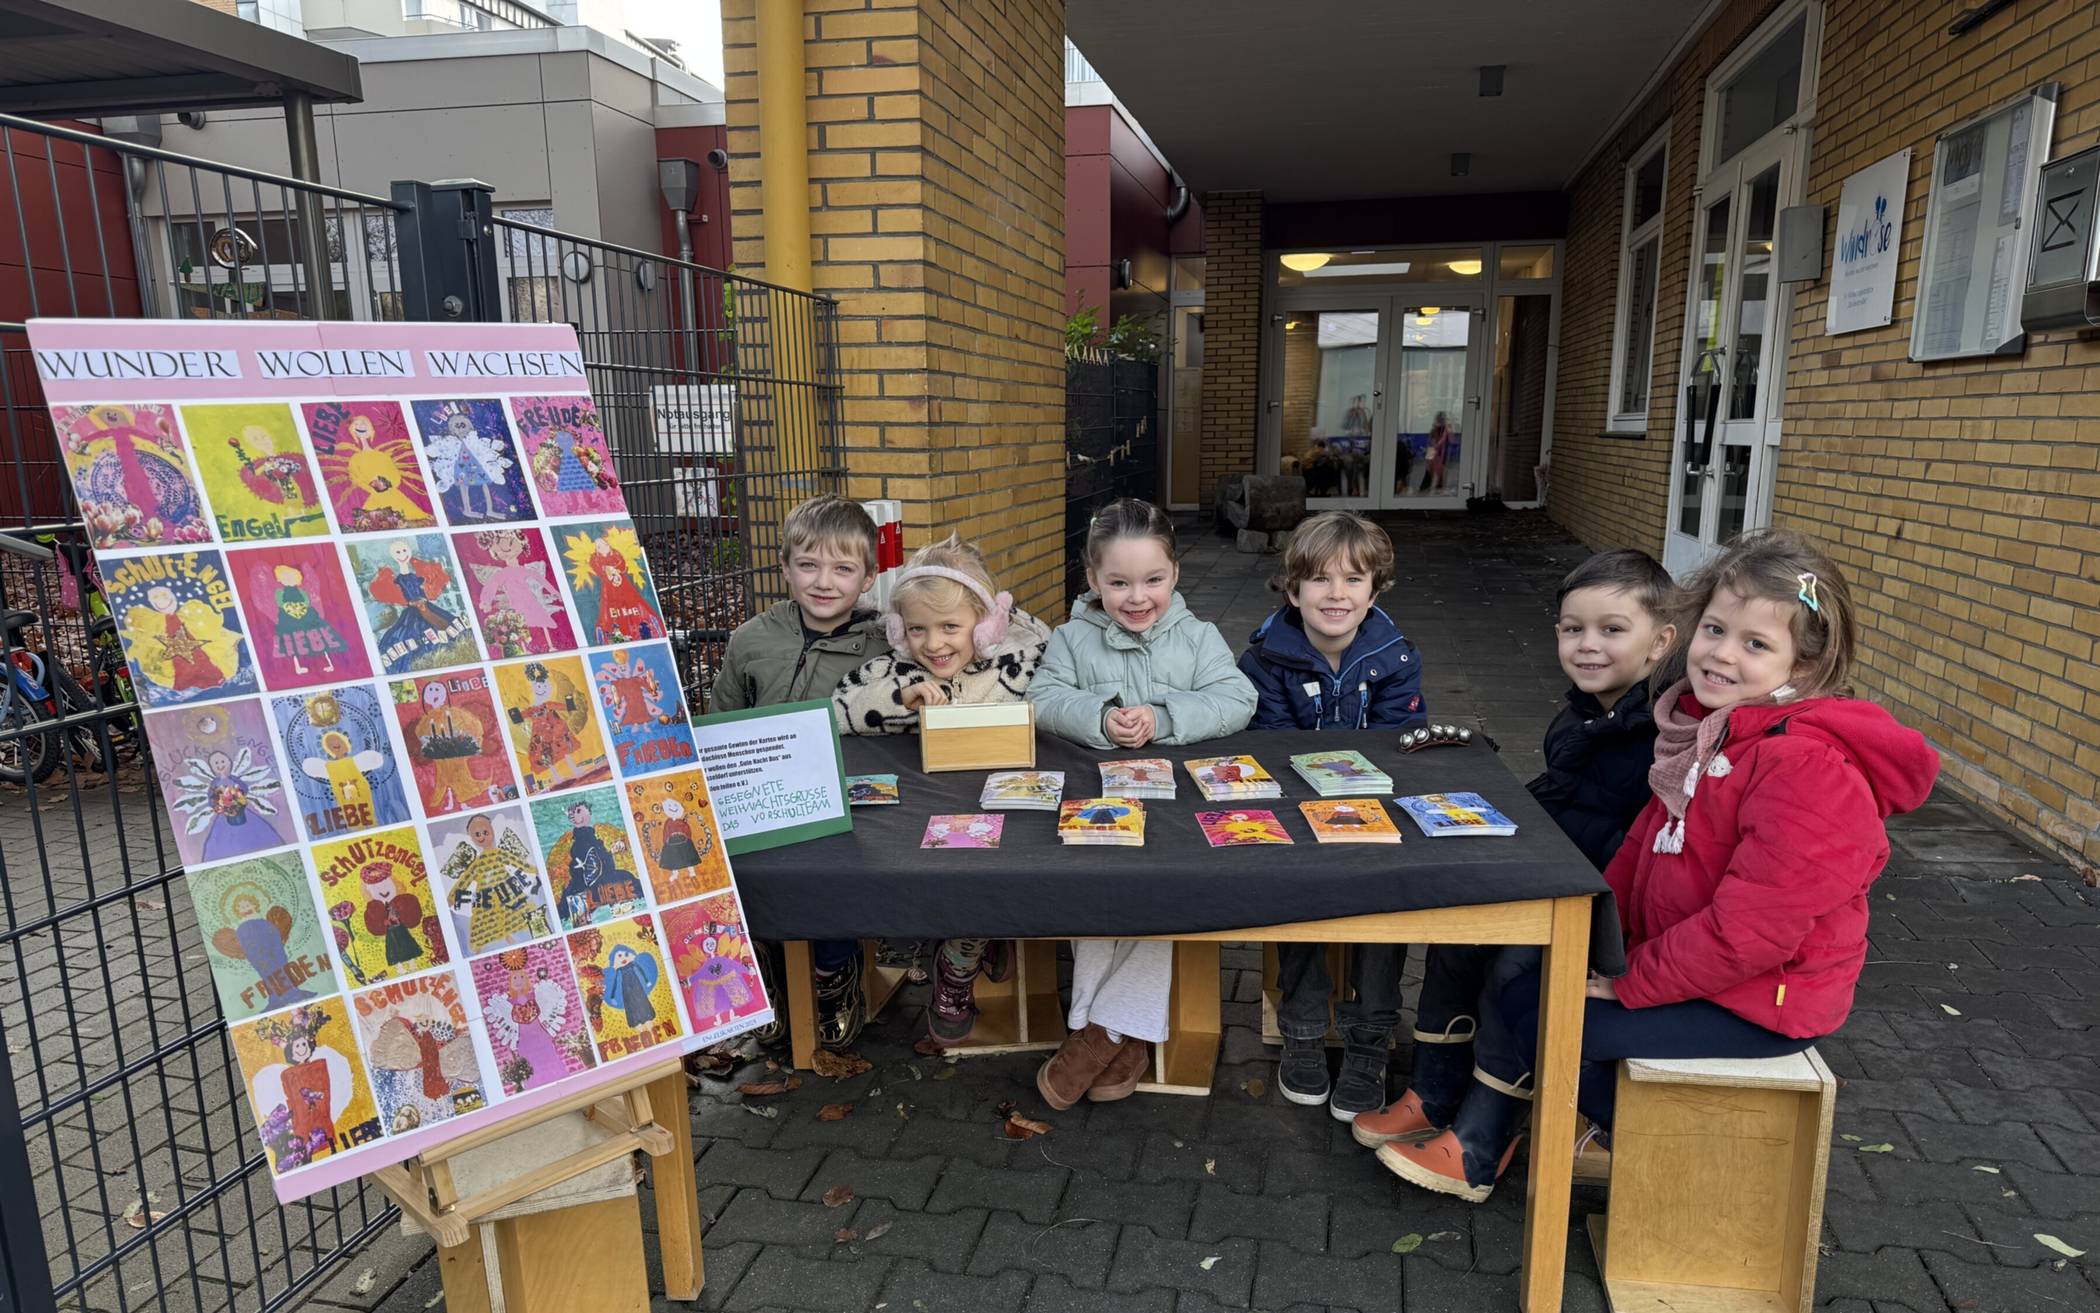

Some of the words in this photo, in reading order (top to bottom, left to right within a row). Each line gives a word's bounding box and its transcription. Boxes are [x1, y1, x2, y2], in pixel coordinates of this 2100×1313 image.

[39, 350, 237, 378] WUNDER
[257, 350, 405, 377] WOLLEN
[429, 352, 583, 377] WACHSEN
[657, 408, 730, 422] Notausgang
[271, 627, 340, 659] LIEBE
[704, 743, 728, 754] gesamte
[728, 741, 749, 750] Gewinn
[759, 736, 777, 744] Karten
[701, 753, 727, 762] dachlose
[727, 748, 755, 758] Menschen
[707, 764, 726, 773] wollen
[753, 756, 769, 765] Nacht
[718, 779, 785, 806] GESEGNETE
[305, 803, 374, 836] LIEBE
[721, 819, 740, 832] DAS
